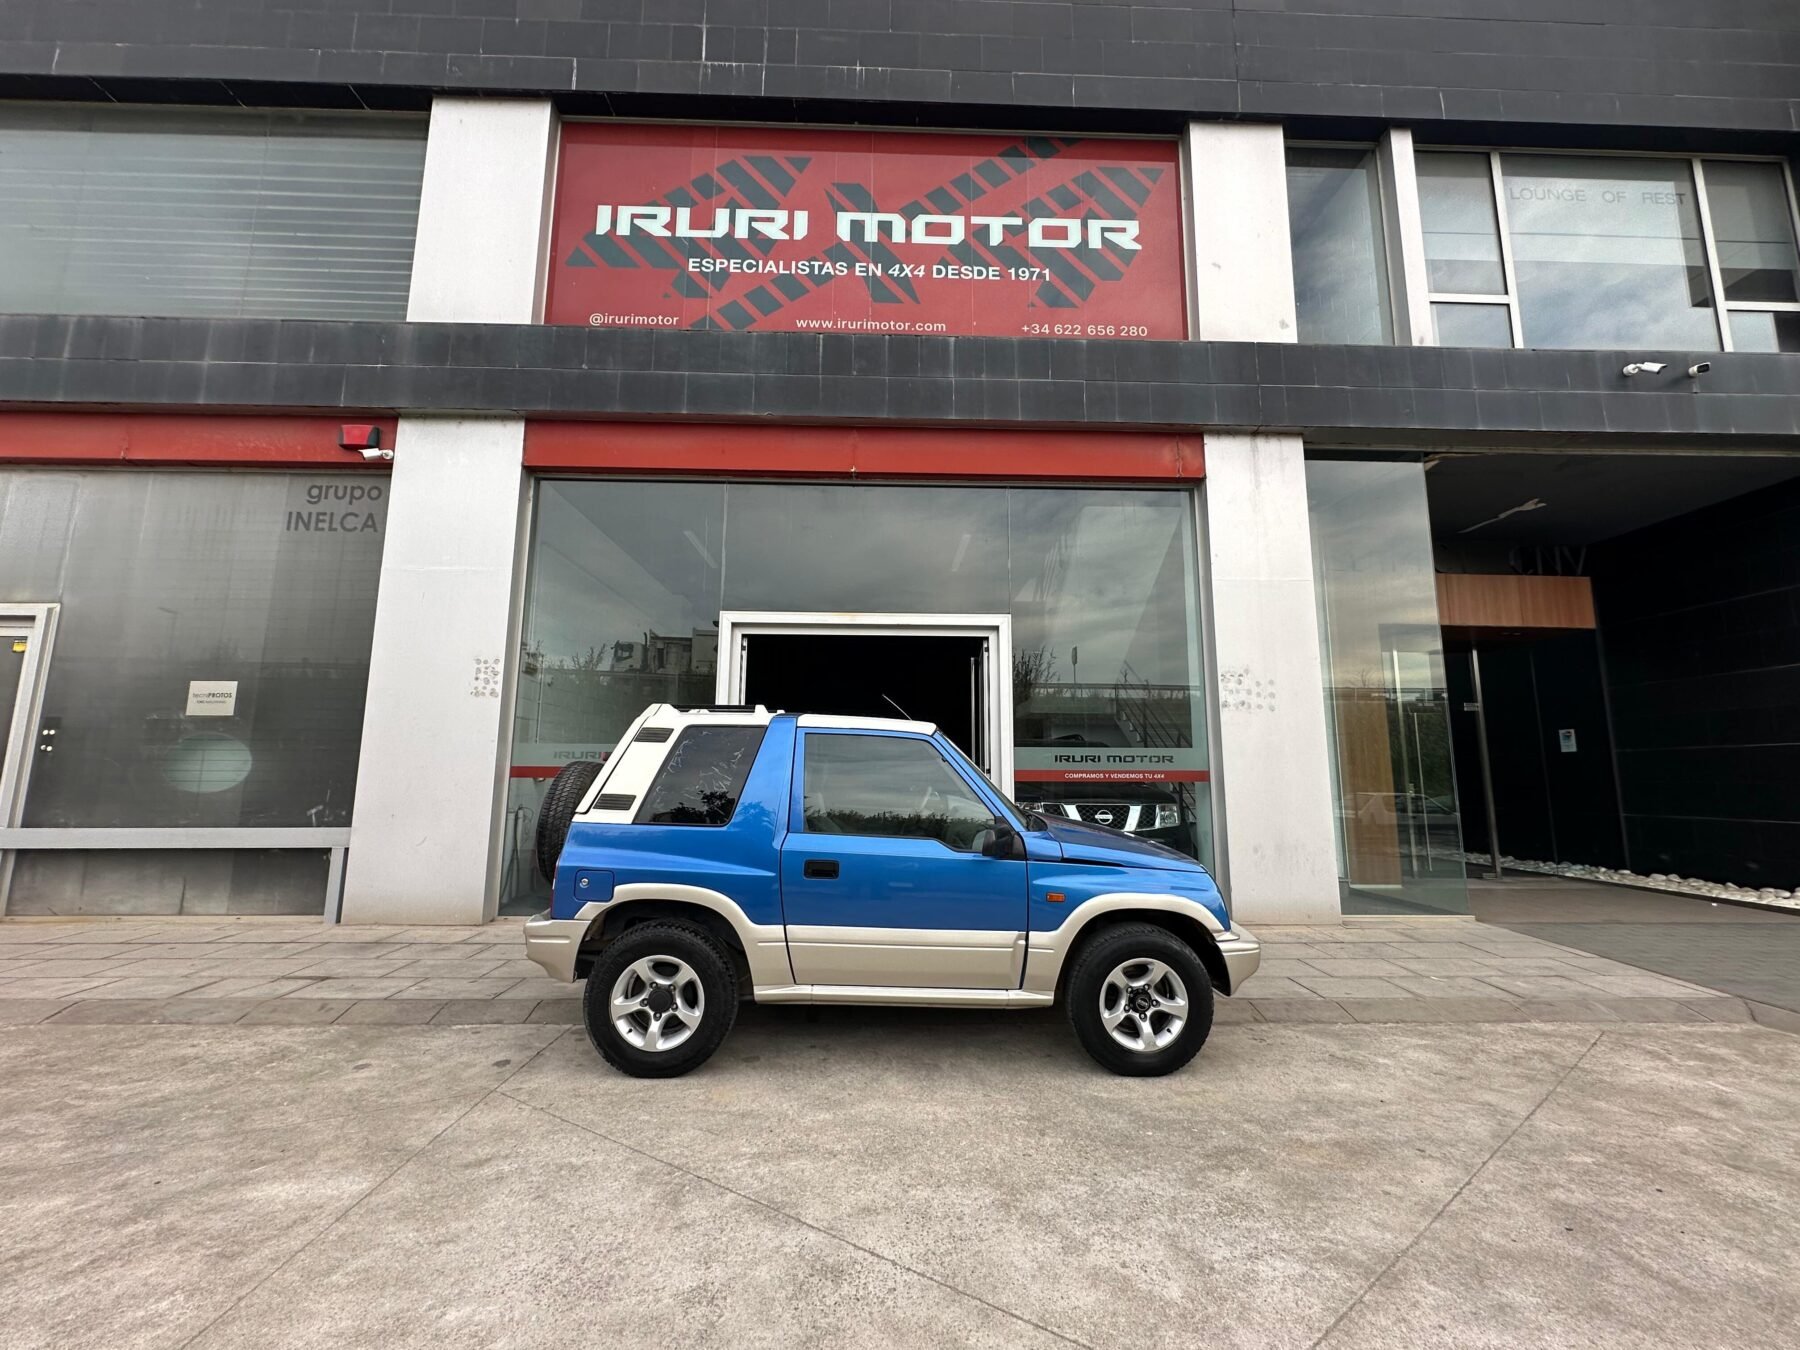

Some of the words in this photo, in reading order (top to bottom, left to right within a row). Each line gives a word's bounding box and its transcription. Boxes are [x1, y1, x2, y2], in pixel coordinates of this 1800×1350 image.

[1509, 187, 1586, 202] LOUNGE
[1601, 190, 1627, 204] OF
[1641, 192, 1686, 205] REST
[595, 205, 809, 241] IRURI
[836, 211, 1143, 250] MOTOR
[688, 258, 848, 276] ESPECIALISTAS
[855, 262, 882, 277] EN
[888, 263, 926, 278] 4X4
[932, 265, 1000, 280] DESDE
[1007, 267, 1050, 281] 1971
[589, 312, 679, 326] @irurimotor
[796, 318, 947, 332] www.irurimotor.com
[1021, 323, 1050, 335] +34
[1054, 324, 1082, 335] 622
[1087, 325, 1115, 336] 656
[1120, 326, 1148, 337] 280
[306, 484, 382, 505] grupo
[286, 511, 378, 532] INELCA
[1054, 755, 1101, 763] IRURI
[1107, 755, 1174, 763] MOTOR
